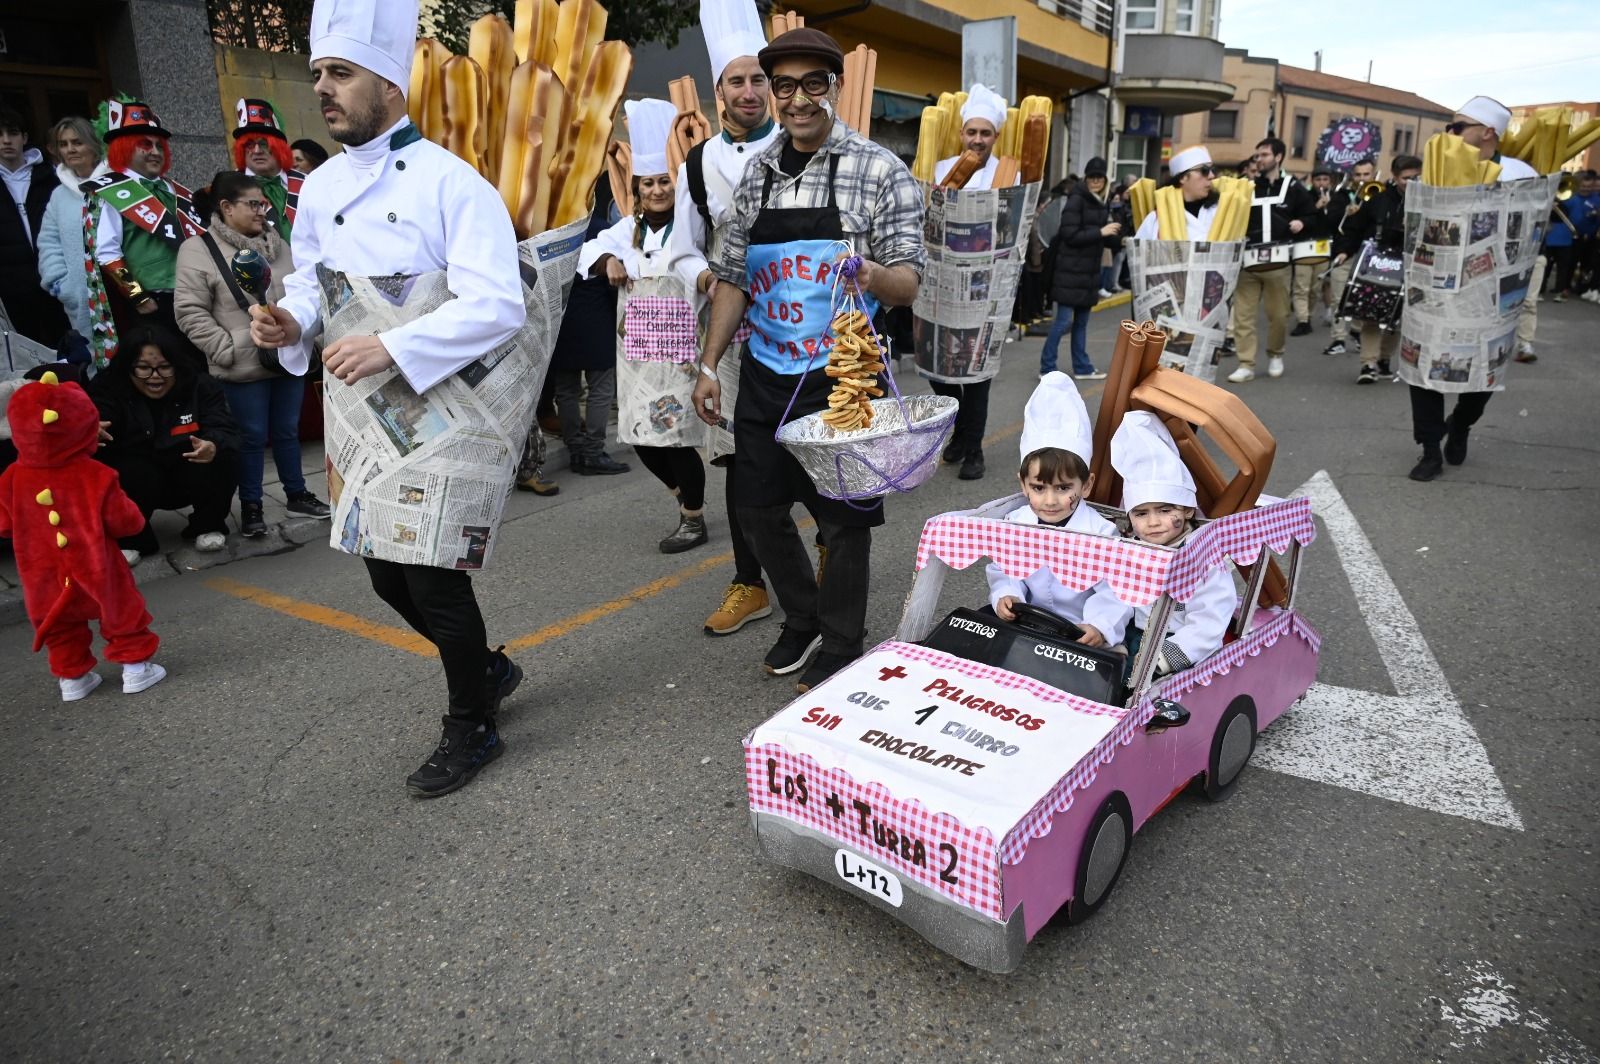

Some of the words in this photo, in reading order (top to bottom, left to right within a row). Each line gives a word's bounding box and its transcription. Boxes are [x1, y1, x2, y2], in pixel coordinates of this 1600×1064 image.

[135, 204, 158, 225] 18
[164, 223, 177, 239] 1
[646, 321, 687, 333] CHURROS
[767, 301, 804, 324] LOS
[948, 616, 999, 639] VIVEROS
[1033, 643, 1098, 672] CUEVAS
[846, 691, 890, 711] QUE
[914, 705, 939, 726] 1
[939, 720, 1021, 757] CHURRO
[922, 678, 1046, 731] PELIGROSOS
[801, 706, 843, 731] SIN
[858, 729, 986, 777] CHOCOLATE
[841, 853, 891, 897] L+T2
[938, 842, 959, 885] 2
